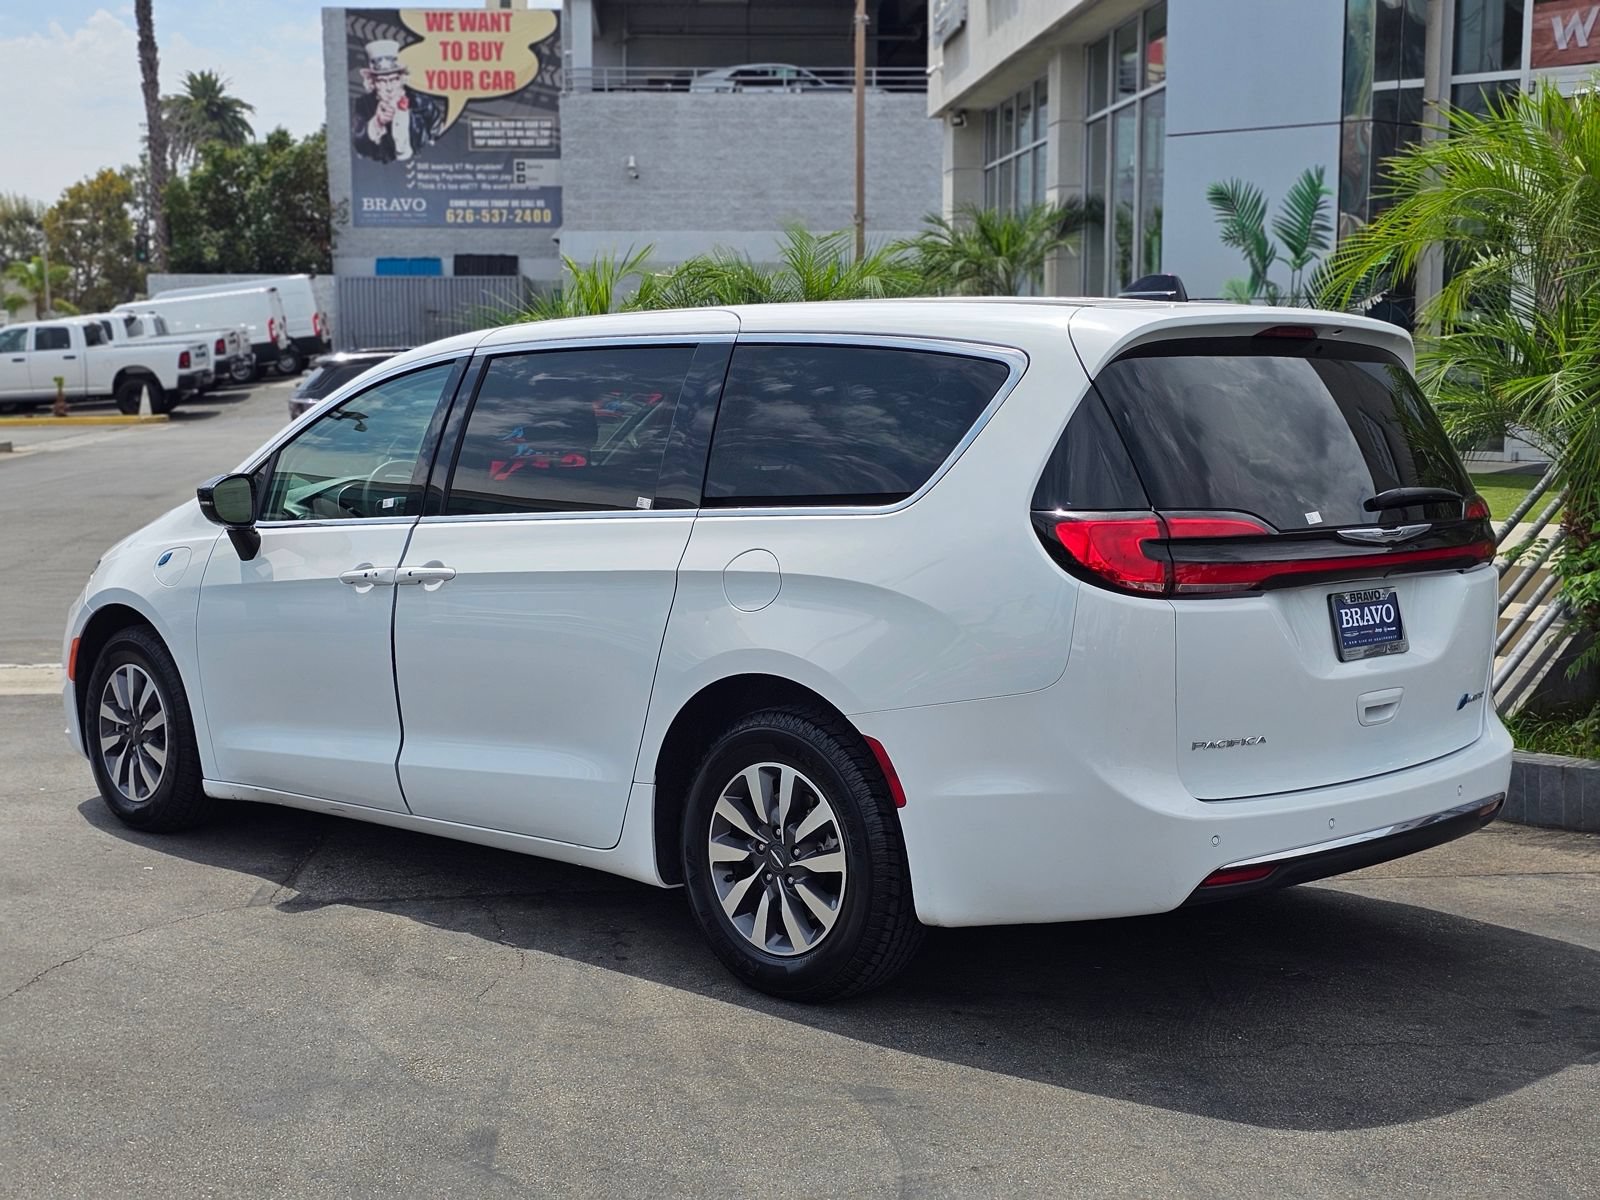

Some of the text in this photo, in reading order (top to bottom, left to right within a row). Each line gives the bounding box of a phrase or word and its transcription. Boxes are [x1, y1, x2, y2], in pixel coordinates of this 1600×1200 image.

[425, 12, 513, 32] WE WANT
[440, 41, 504, 62] TO BUY
[425, 70, 516, 90] YOUR CAR
[362, 197, 426, 212] BRAVO
[446, 208, 552, 223] 626-537-2400
[1350, 590, 1380, 602] BRAVO
[1340, 604, 1395, 628] BRAVO
[1192, 735, 1266, 750] PACIFICA
